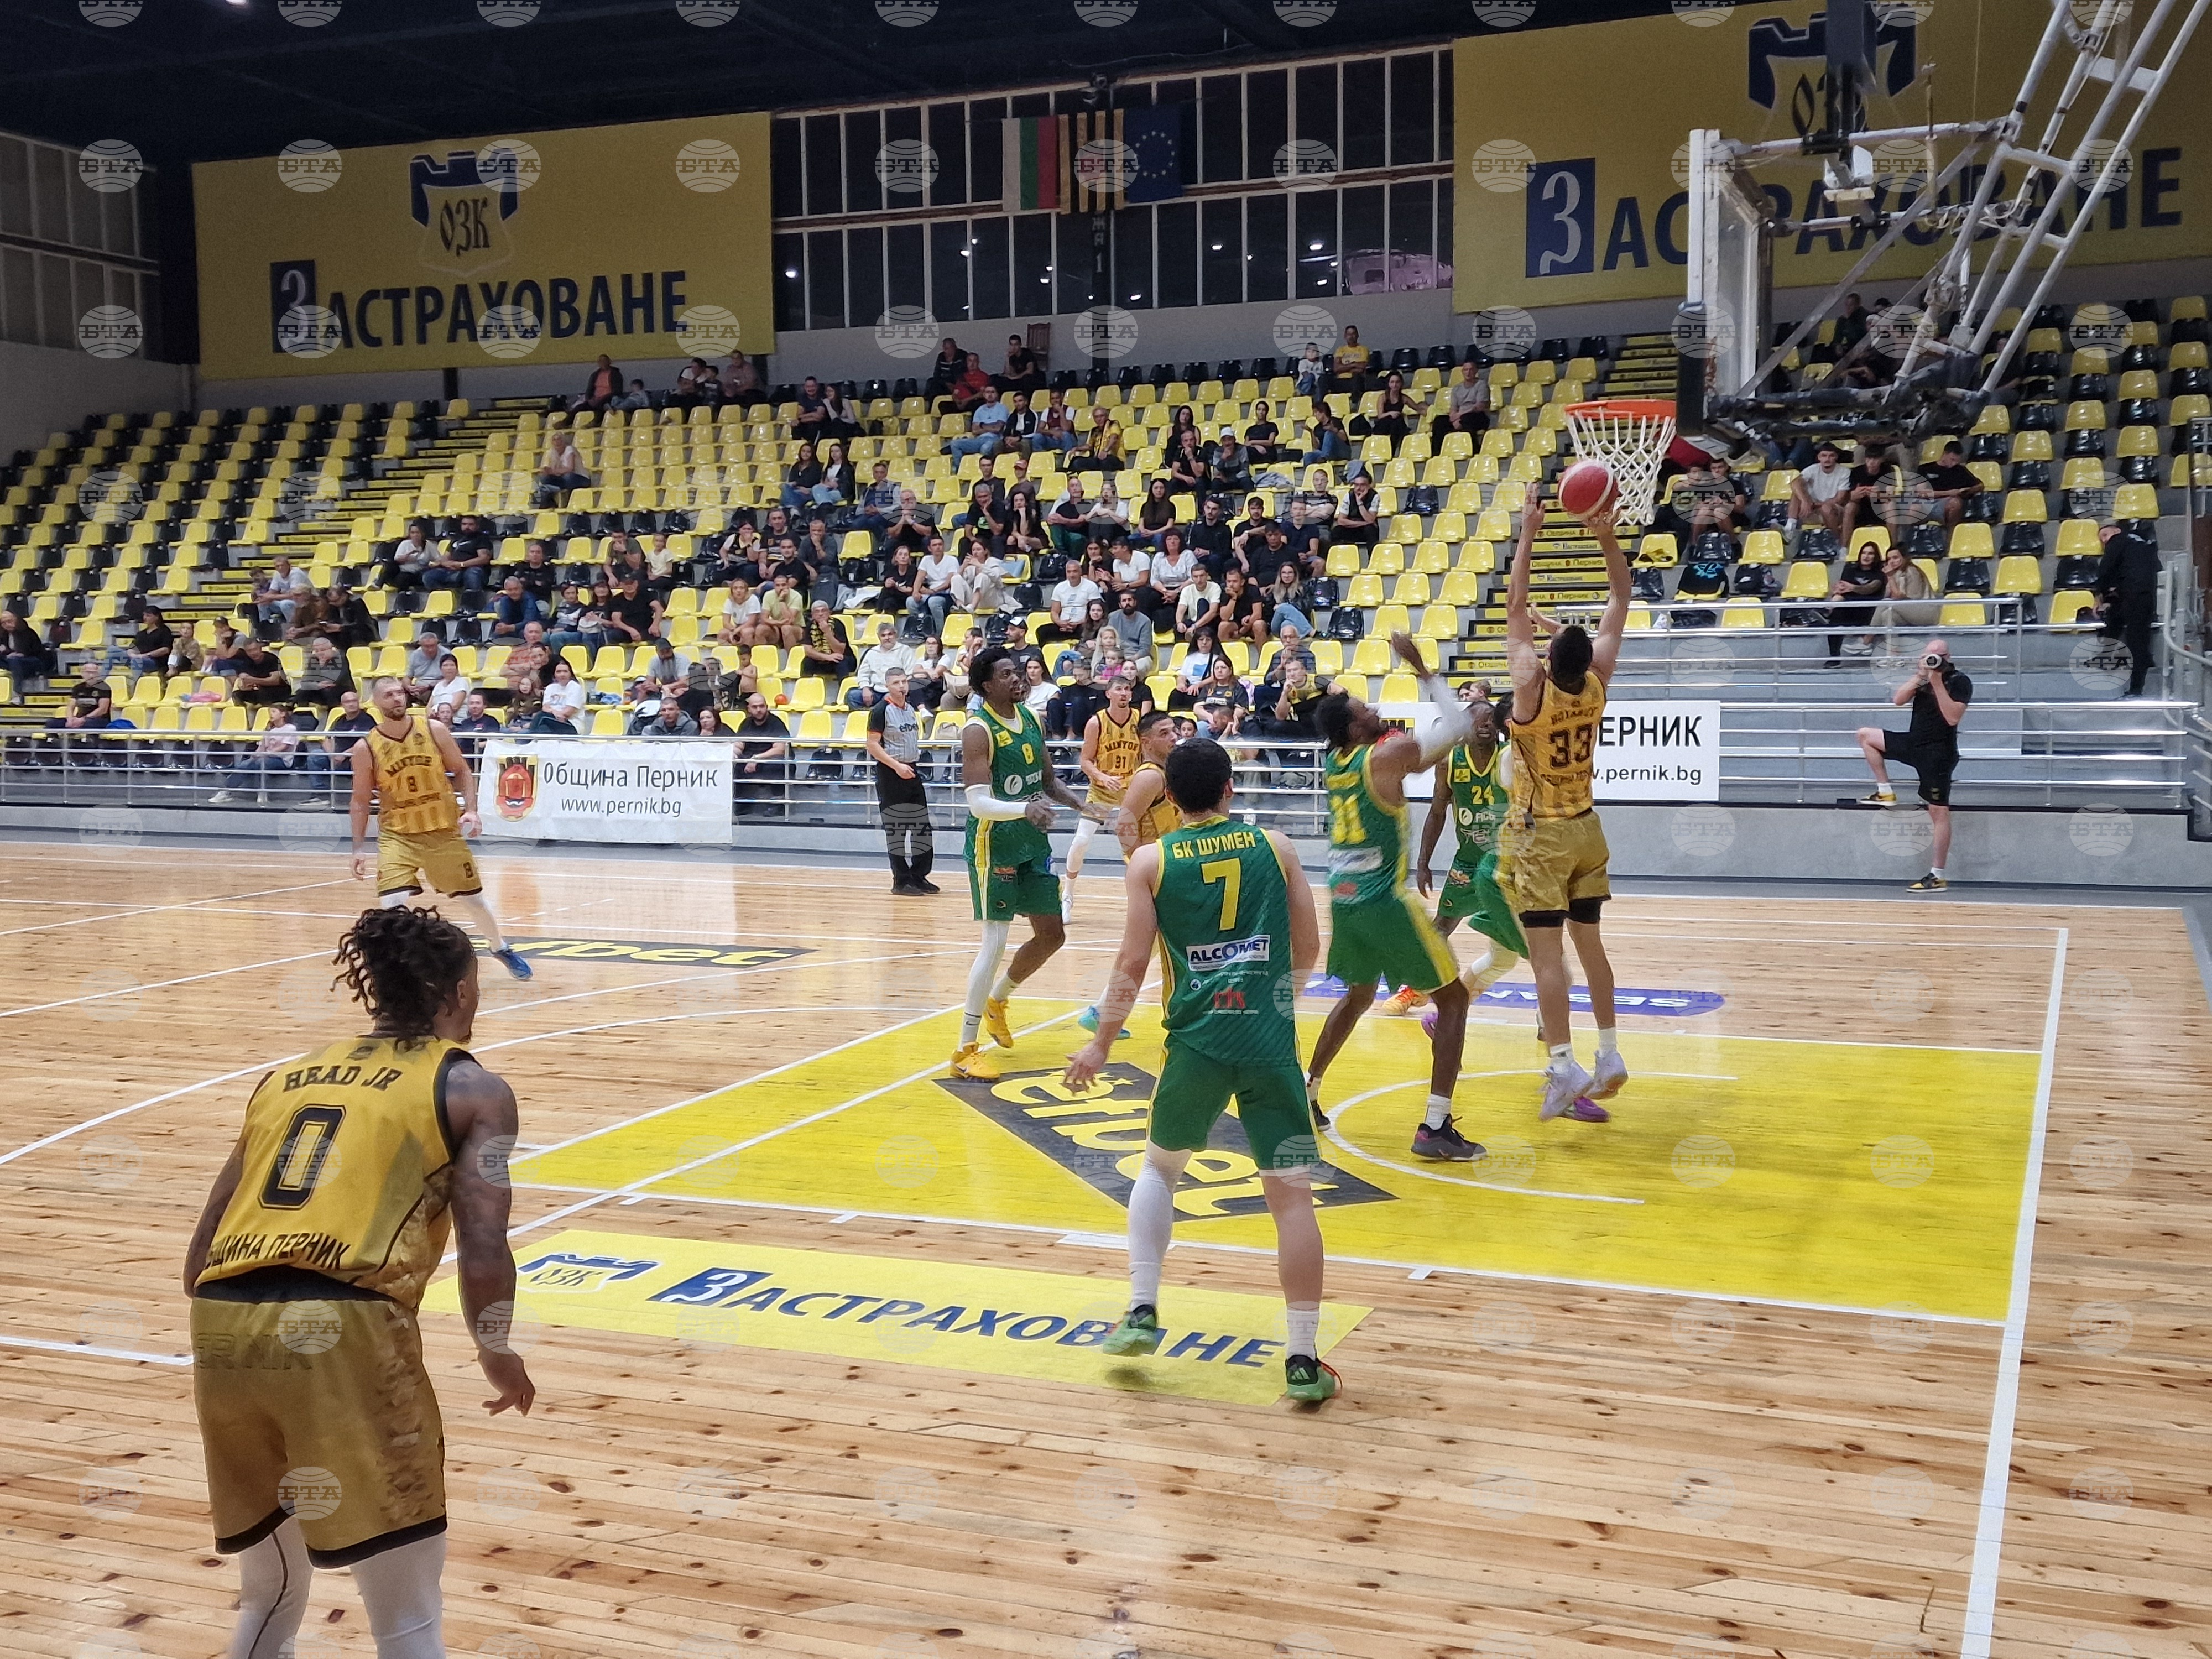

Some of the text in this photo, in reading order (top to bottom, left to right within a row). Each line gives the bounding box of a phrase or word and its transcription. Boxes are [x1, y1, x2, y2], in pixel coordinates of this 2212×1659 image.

[440, 196, 491, 258] ОЗК
[1539, 147, 2183, 275] ЗАСРАХОВАНЕ
[280, 269, 687, 351] ЗАСТРАХОВАНЕ
[1549, 722, 1593, 769] 33
[544, 762, 718, 791] Община Перник
[561, 797, 681, 818] www.pernik.bg
[1470, 785, 1495, 805] 24
[1172, 831, 1256, 859] БК ШУМЕН
[1201, 857, 1241, 932] 7
[1191, 938, 1269, 962] ALCOMET
[283, 1065, 403, 1092] HEAD JR
[257, 1103, 347, 1211] 0
[265, 1232, 352, 1270] ПЕРНИК
[530, 1267, 602, 1287] ОЗК
